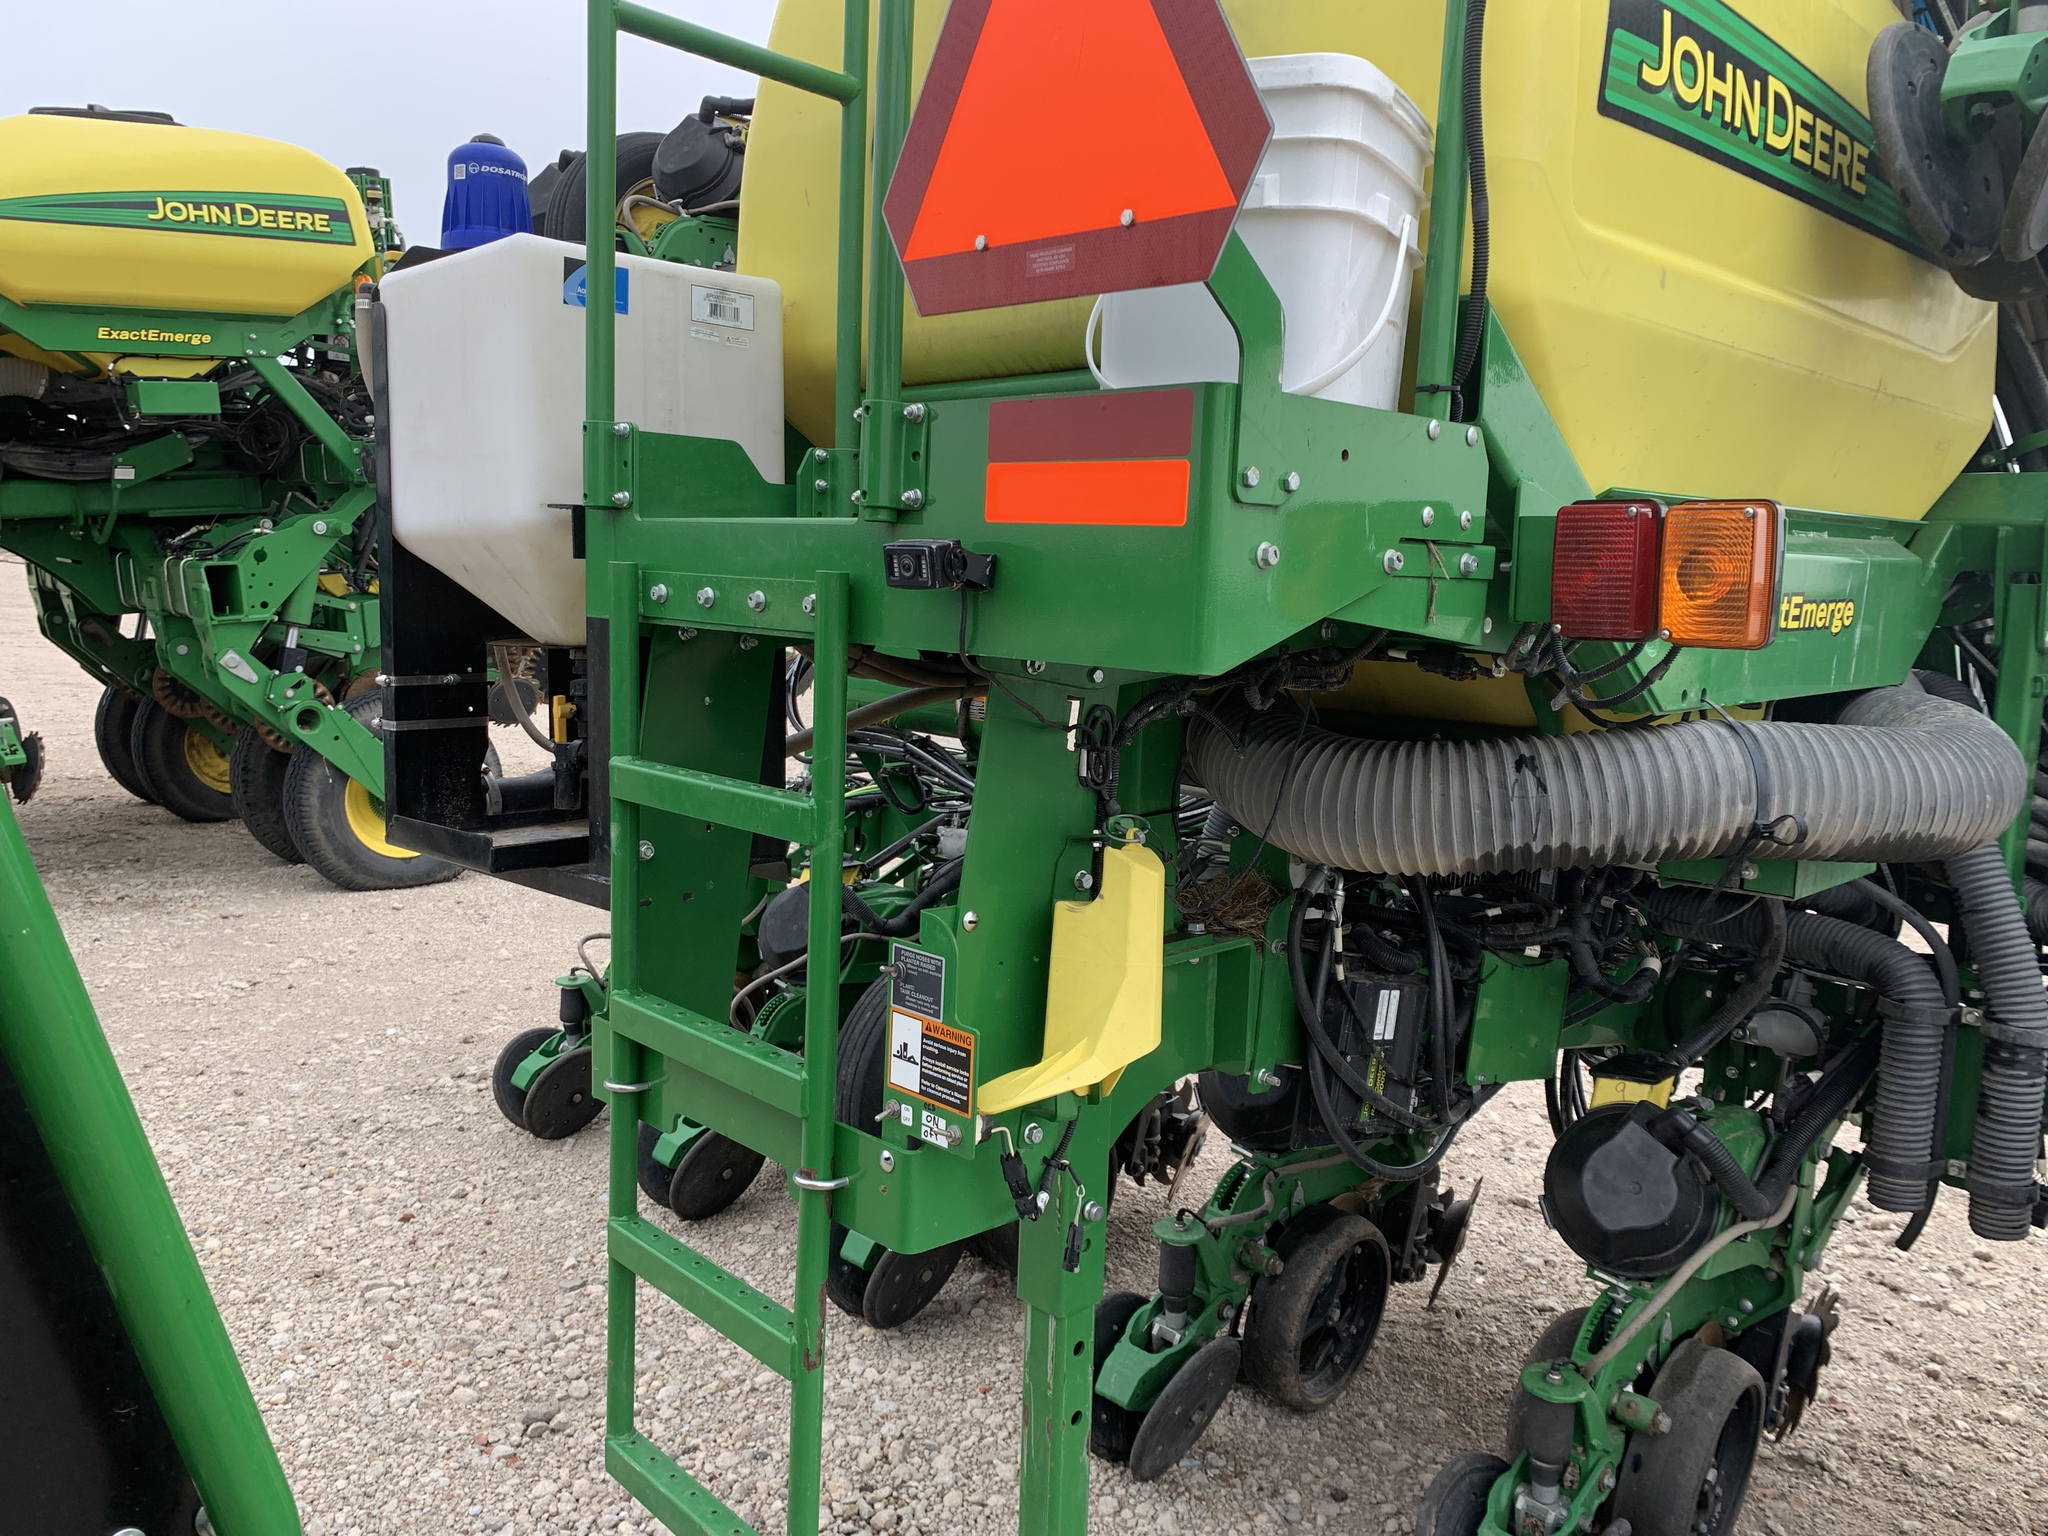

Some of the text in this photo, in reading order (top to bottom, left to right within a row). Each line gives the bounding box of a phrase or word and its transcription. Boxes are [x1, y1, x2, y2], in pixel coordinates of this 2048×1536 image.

[1642, 9, 1869, 195] JOHN DEERE
[148, 197, 331, 232] JOHN DEERE
[97, 327, 212, 345] ExactEmerge
[1780, 595, 1855, 634] tEmerge
[900, 955, 919, 966] PLANTER
[911, 991, 933, 1003] CLEANOUT
[933, 1024, 971, 1046] WARNING
[923, 1037, 966, 1058] Avoid serious injury from
[922, 1061, 932, 1069] before
[933, 1065, 950, 1077] performing
[952, 1073, 963, 1081] service
[922, 1068, 941, 1079] maintenance
[923, 1055, 934, 1065] Always
[947, 1064, 959, 1073] service
[1368, 1058, 1377, 1087] DEER
[954, 1092, 967, 1101] Manual
[1615, 1081, 1626, 1101] 9
[925, 1114, 939, 1128] ON
